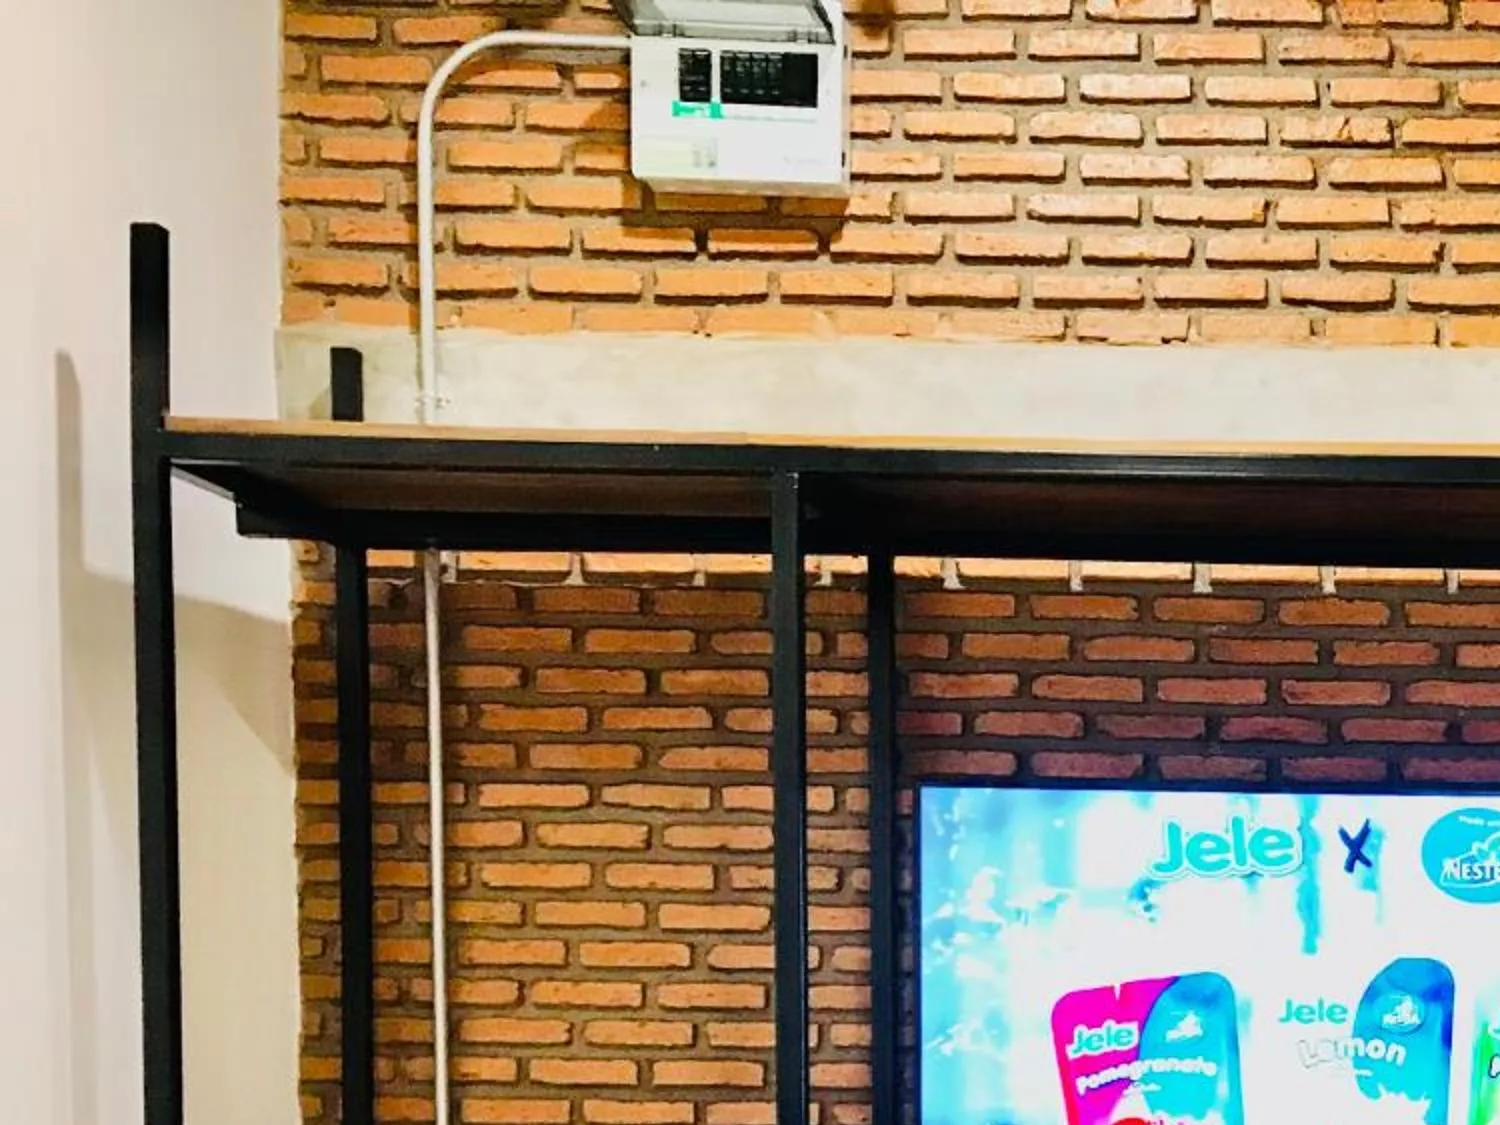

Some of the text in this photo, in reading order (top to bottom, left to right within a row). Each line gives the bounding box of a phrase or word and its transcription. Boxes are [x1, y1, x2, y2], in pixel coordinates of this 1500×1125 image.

[1151, 815, 1296, 874] Jele
[1277, 997, 1349, 1025] Jele
[1069, 1022, 1136, 1057] Jele
